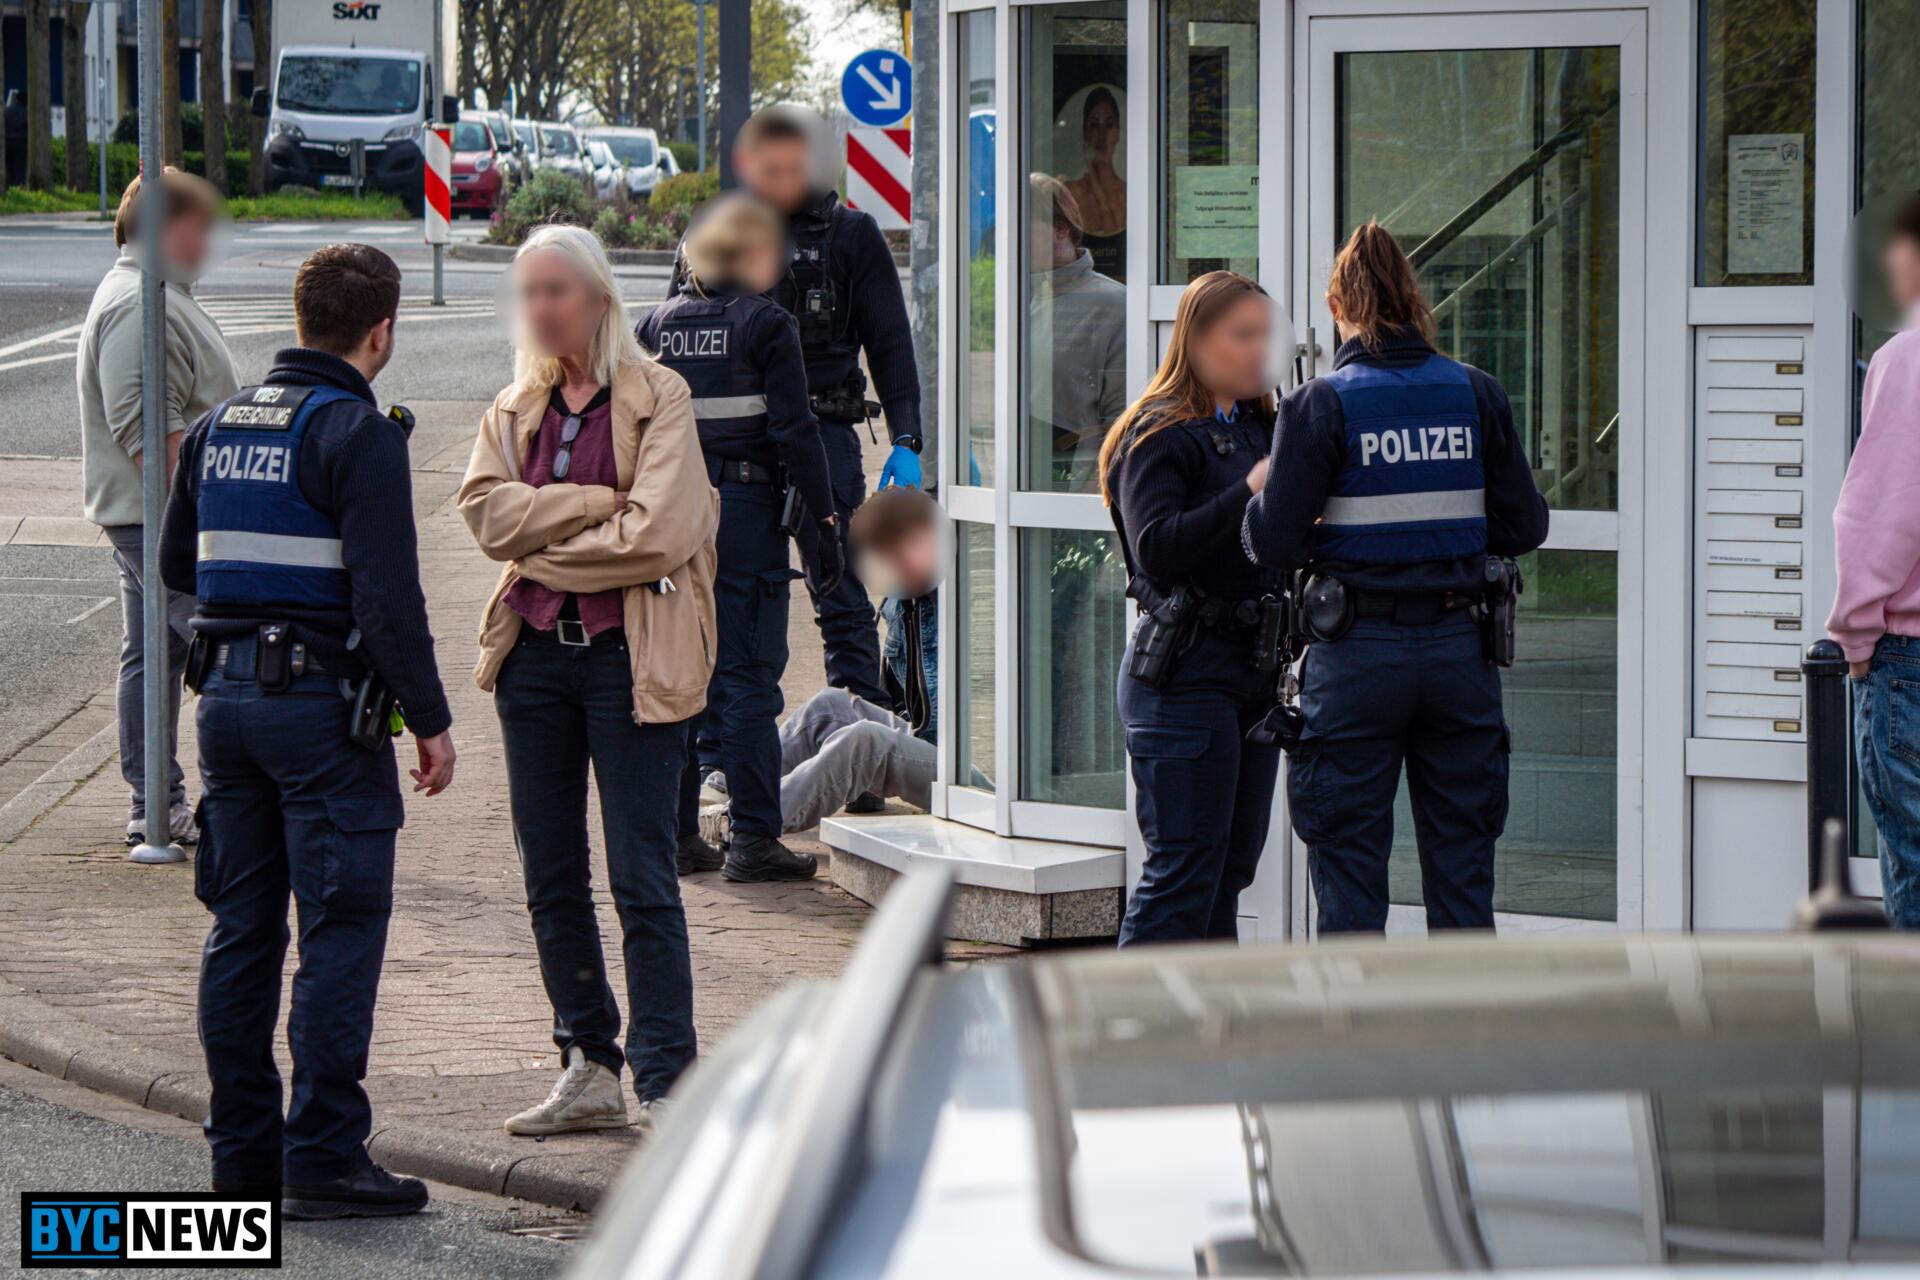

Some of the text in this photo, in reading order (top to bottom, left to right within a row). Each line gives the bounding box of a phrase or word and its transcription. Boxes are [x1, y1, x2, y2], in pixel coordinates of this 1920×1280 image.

[332, 2, 381, 20] SIXT
[660, 329, 728, 356] POLIZEI
[220, 405, 292, 425] AUFZEICHNUNG
[1360, 426, 1473, 466] POLIZEI
[202, 445, 291, 483] POLIZEI
